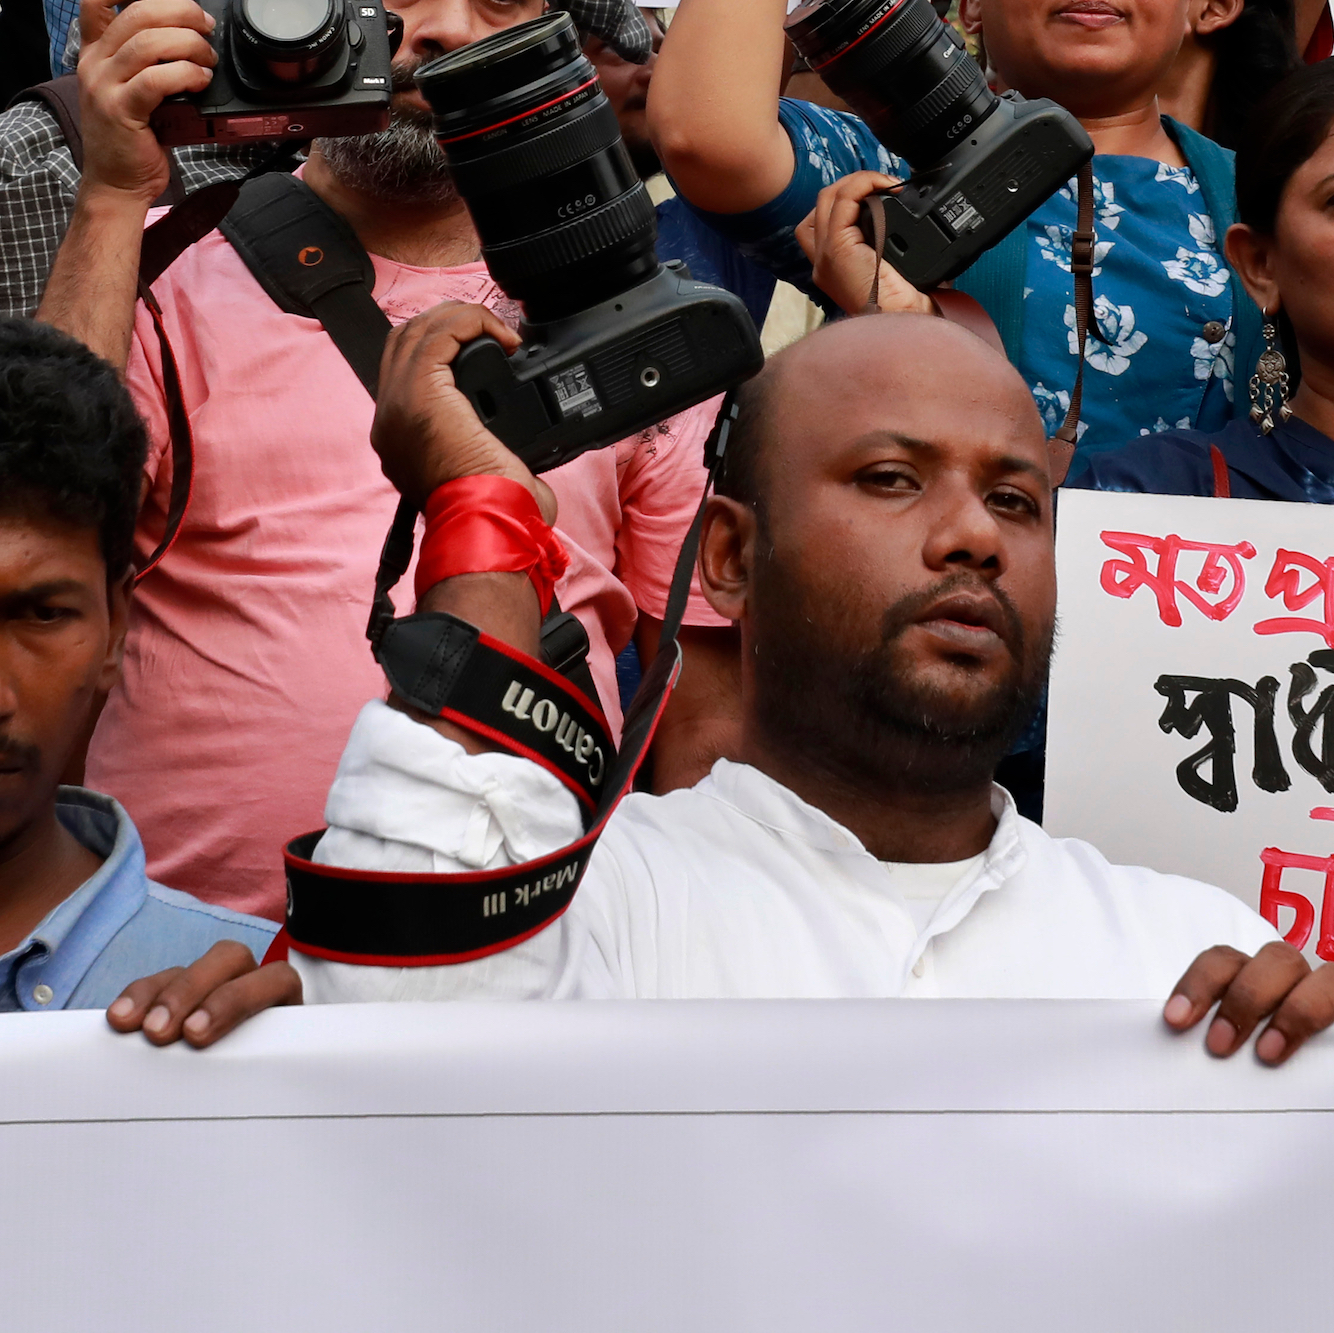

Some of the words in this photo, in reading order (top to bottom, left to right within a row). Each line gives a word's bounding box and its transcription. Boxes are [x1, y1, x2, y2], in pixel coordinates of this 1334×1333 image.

[521, 116, 539, 127] LENS
[543, 105, 563, 117] MADE
[564, 99, 572, 107] IN
[573, 91, 589, 104] JAPAN
[502, 679, 605, 786] Canon
[483, 891, 507, 918] III
[514, 861, 579, 907] Mark
